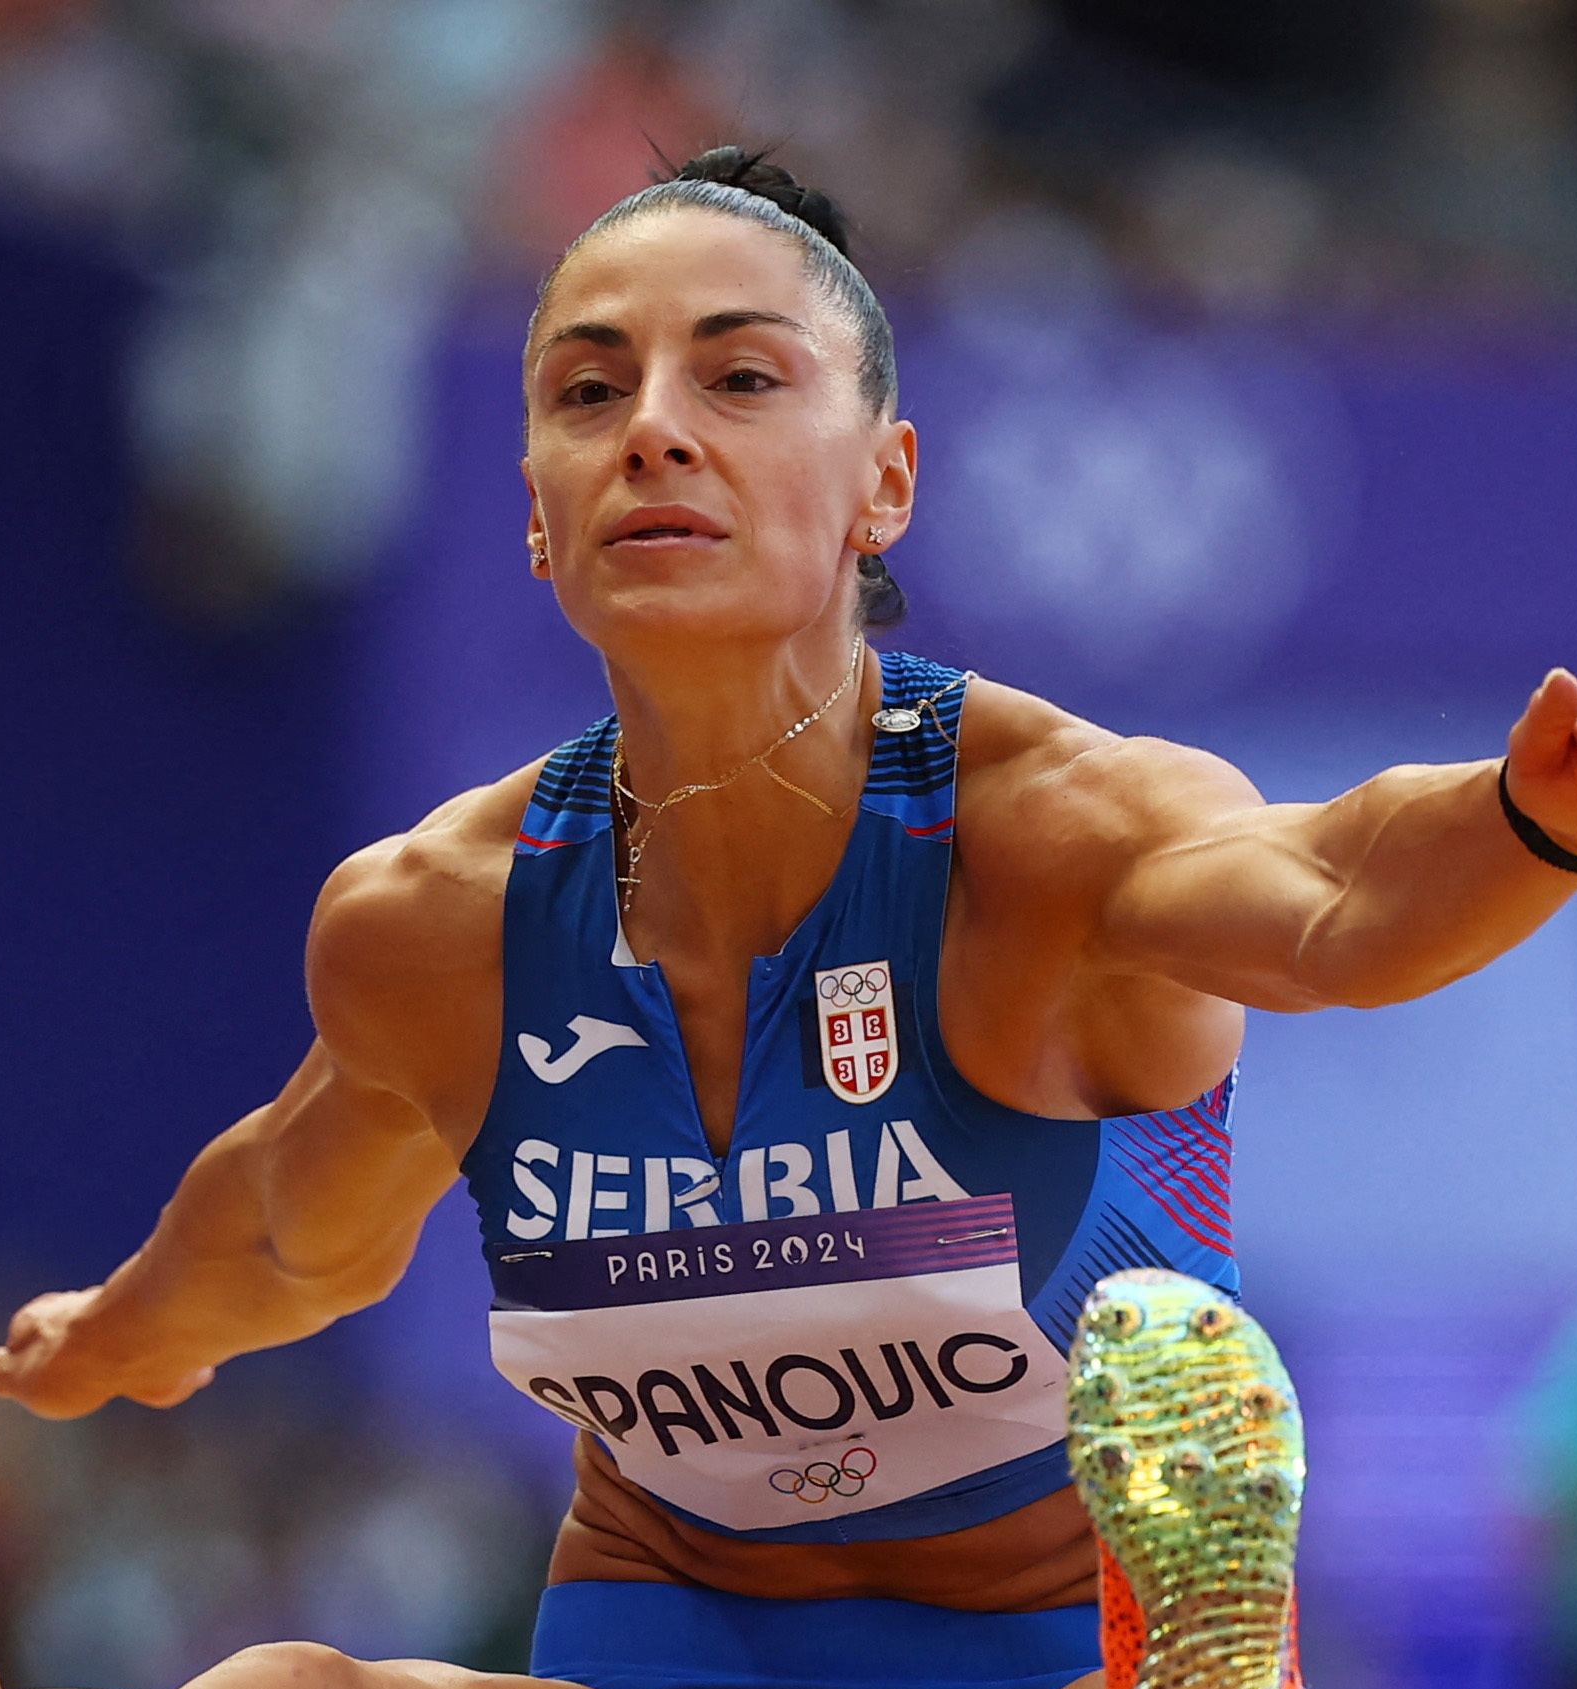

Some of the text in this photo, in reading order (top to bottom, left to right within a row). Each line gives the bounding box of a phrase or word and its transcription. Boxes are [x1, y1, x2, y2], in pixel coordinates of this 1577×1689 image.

[506, 1119, 972, 1240] SERBIA
[754, 1229, 865, 1269] 2024
[528, 1332, 1029, 1456] SPANOVIC
